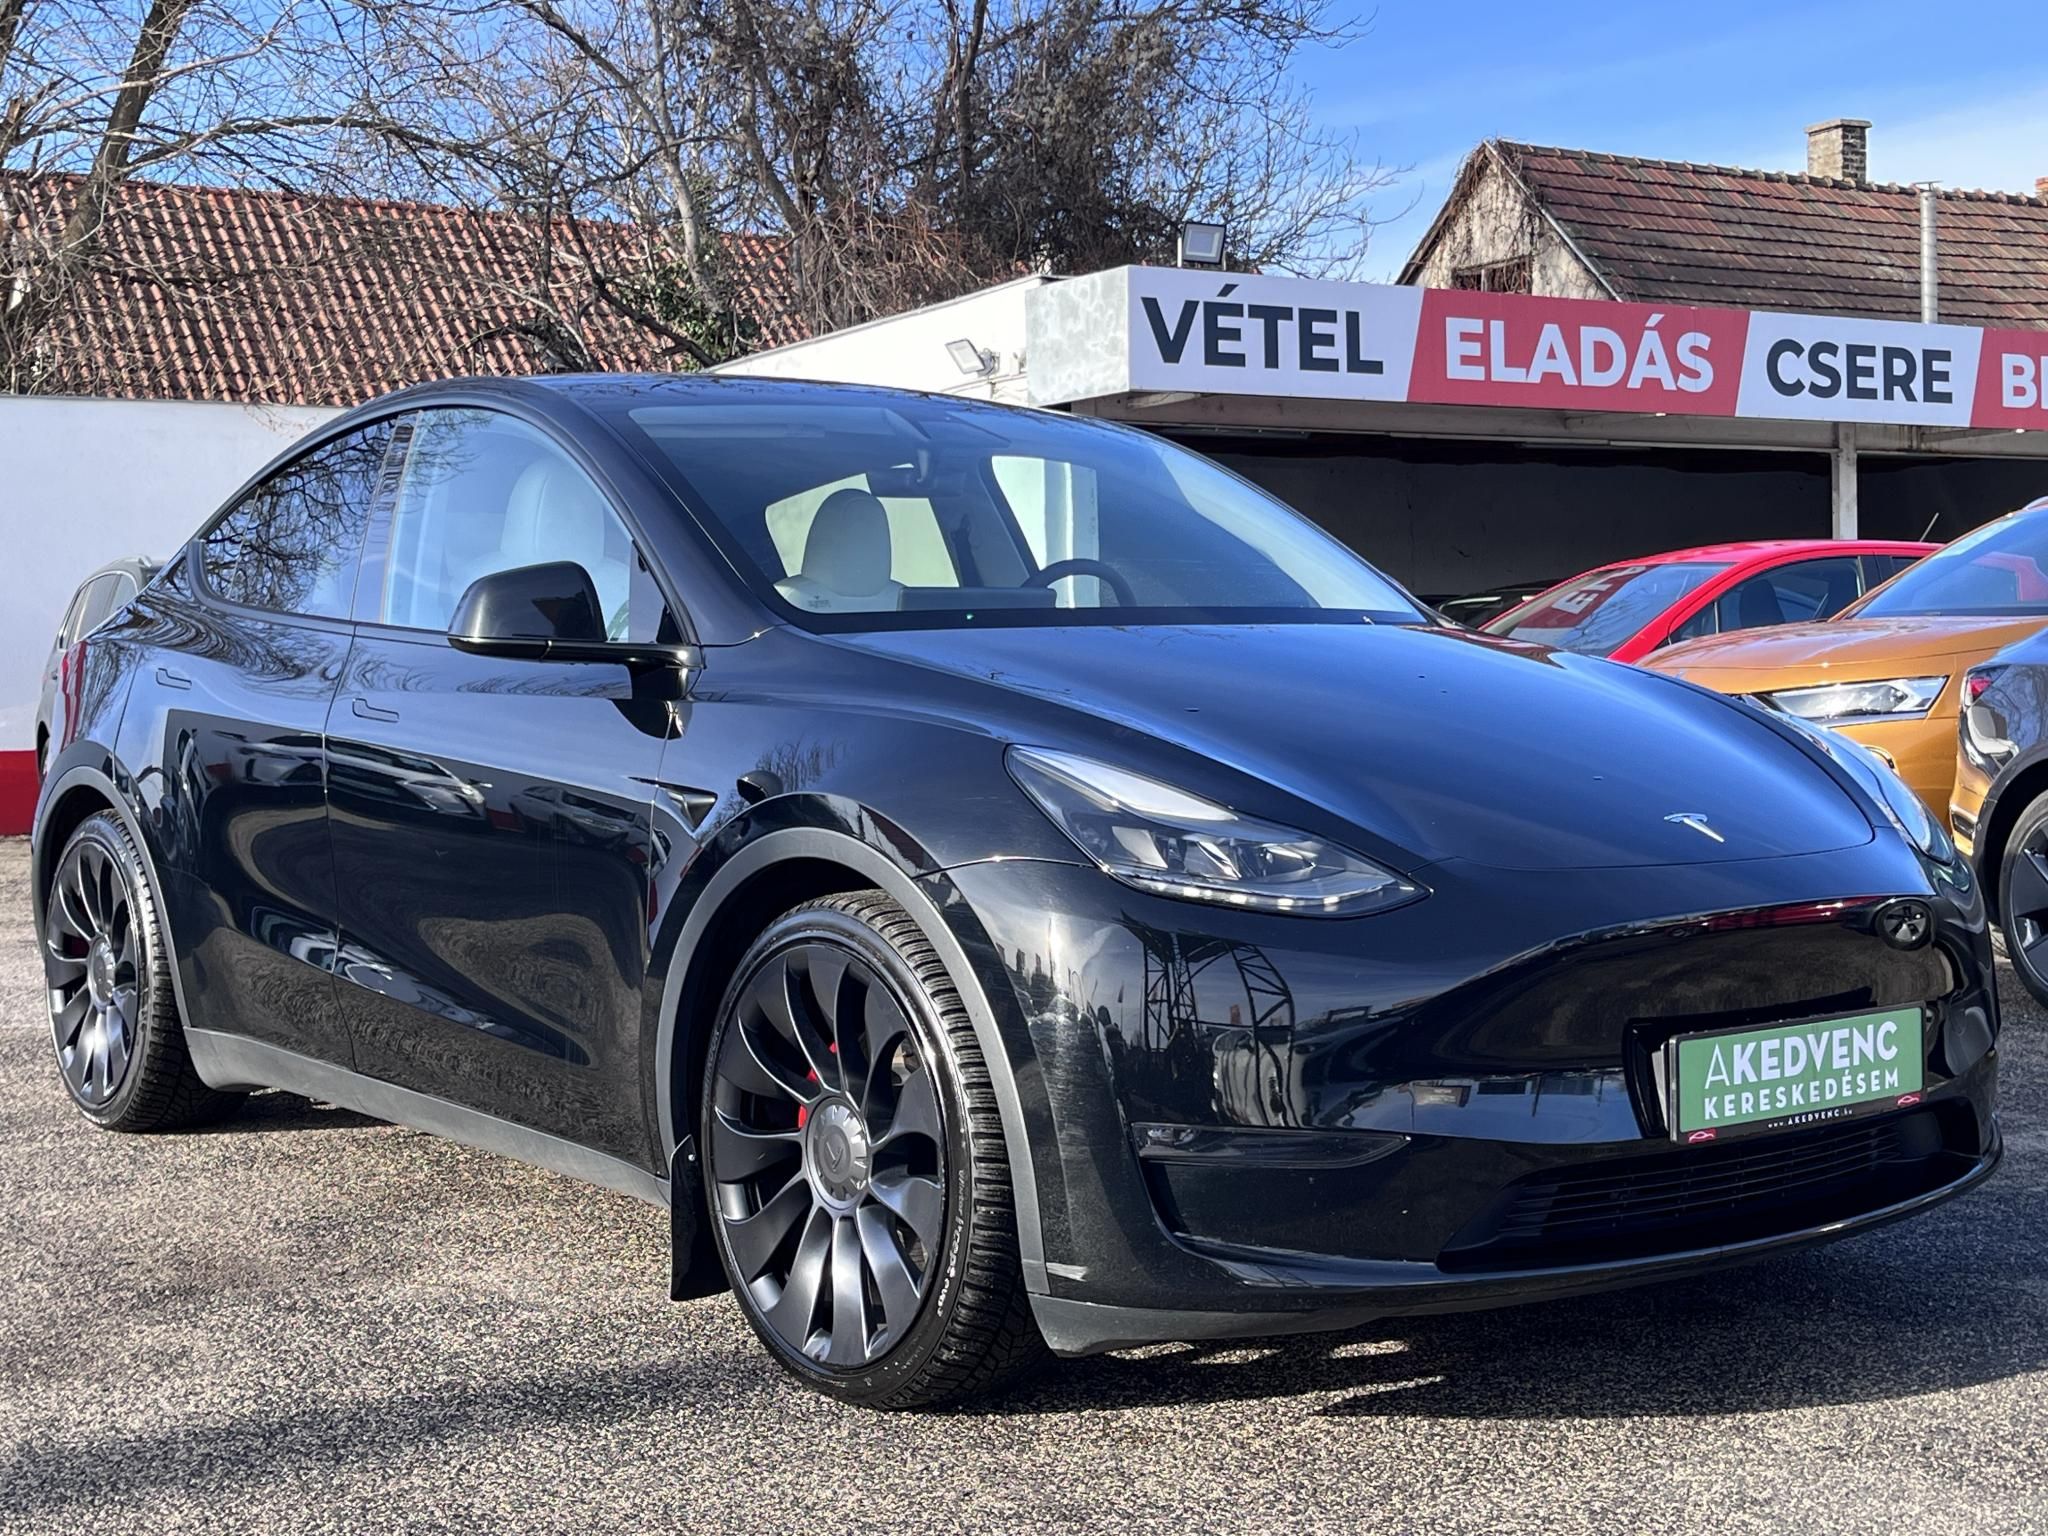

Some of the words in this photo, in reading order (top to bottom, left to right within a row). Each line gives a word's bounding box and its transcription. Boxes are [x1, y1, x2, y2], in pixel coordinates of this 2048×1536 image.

[1140, 282, 1384, 375] VÉTEL
[1445, 313, 1714, 393] ELADÁS
[1766, 338, 1953, 405] CSERE
[2001, 352, 2048, 410] B
[1704, 1067, 1899, 1120] KERESKEDÉSEM
